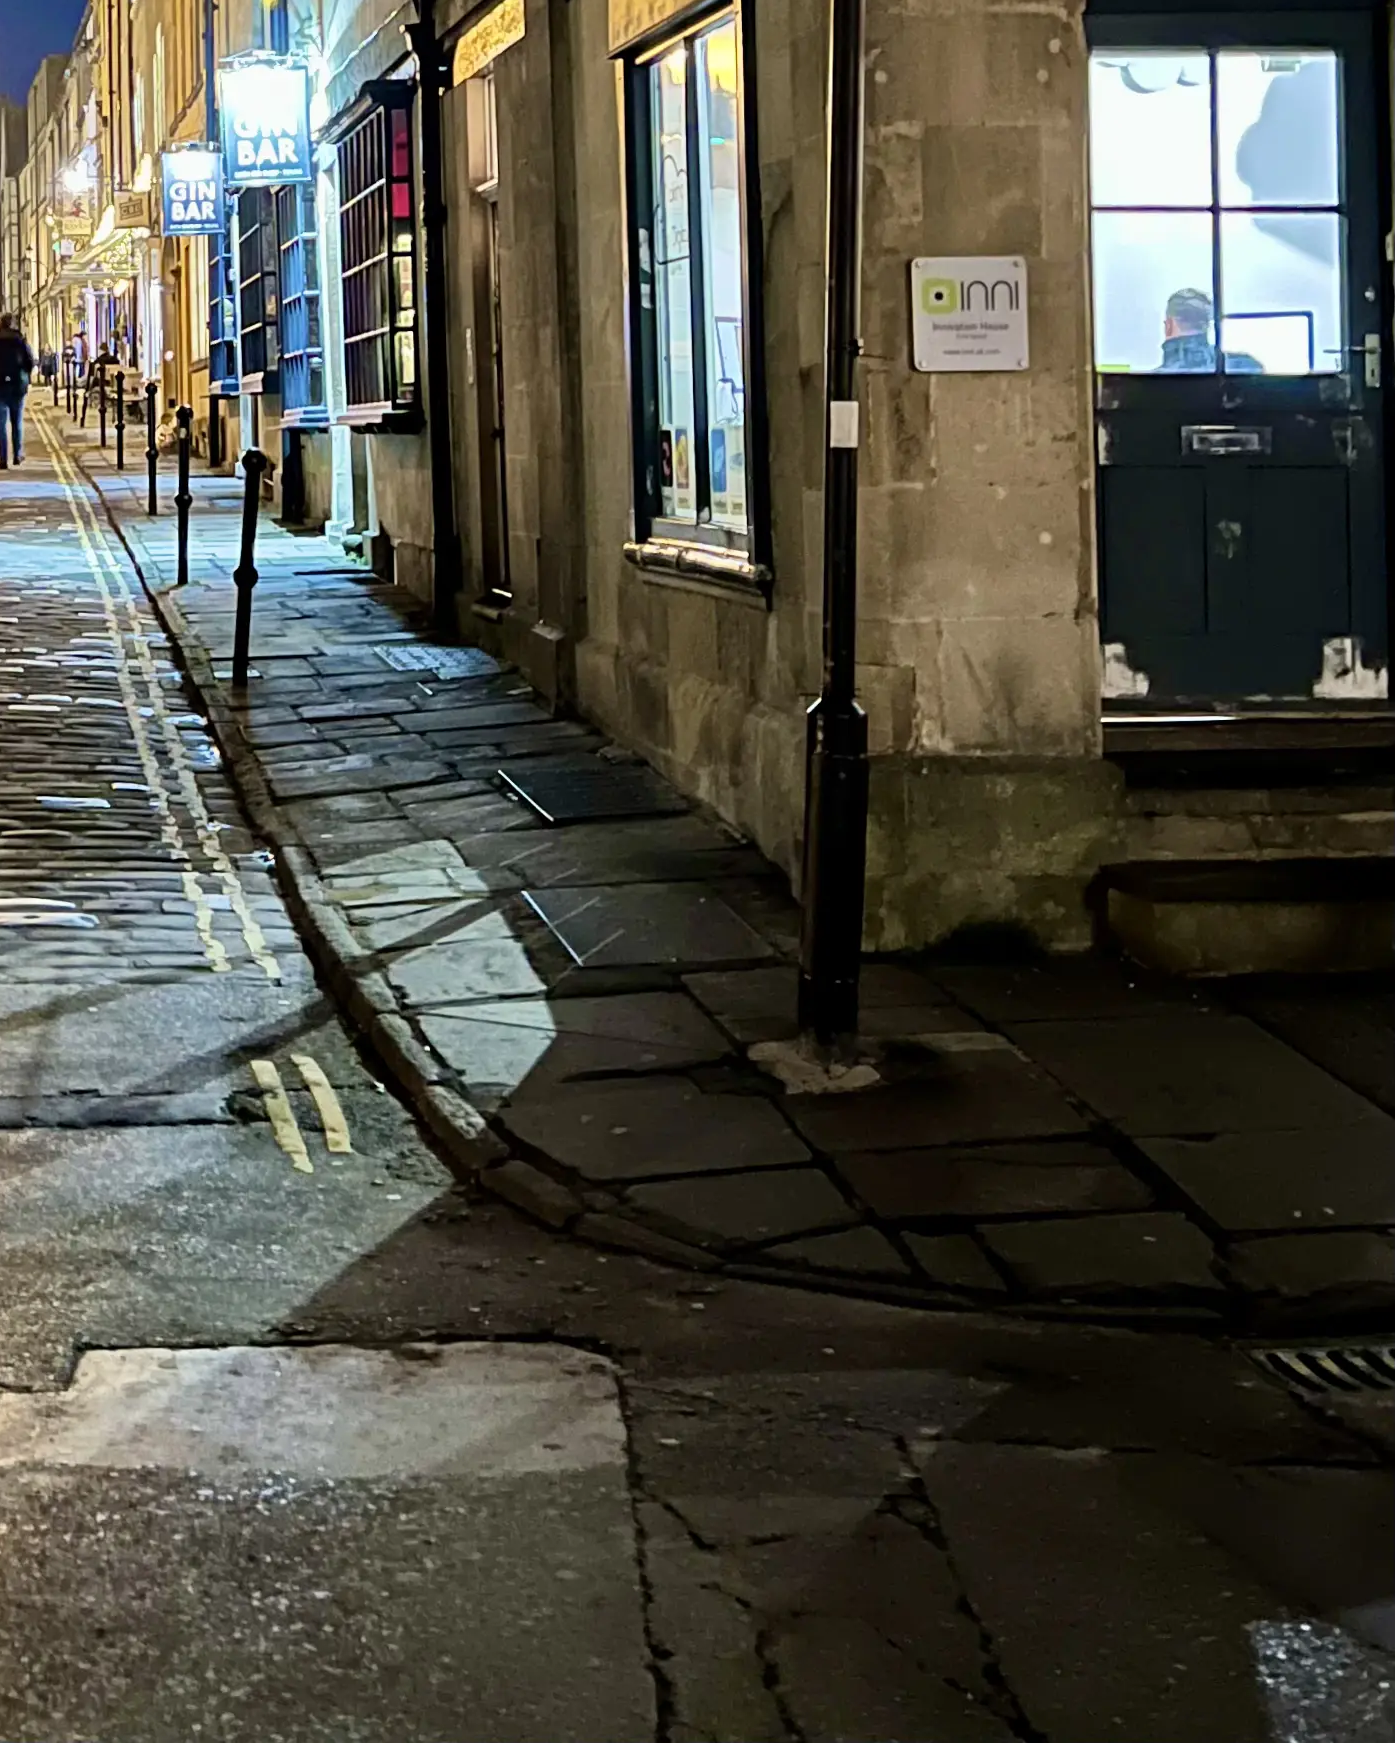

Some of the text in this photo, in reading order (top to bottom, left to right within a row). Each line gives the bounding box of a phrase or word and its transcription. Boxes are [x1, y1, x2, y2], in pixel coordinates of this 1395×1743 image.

[233, 115, 298, 138] GIN
[237, 138, 299, 166] BAR
[169, 181, 216, 201] GIN
[171, 201, 216, 222] BAR
